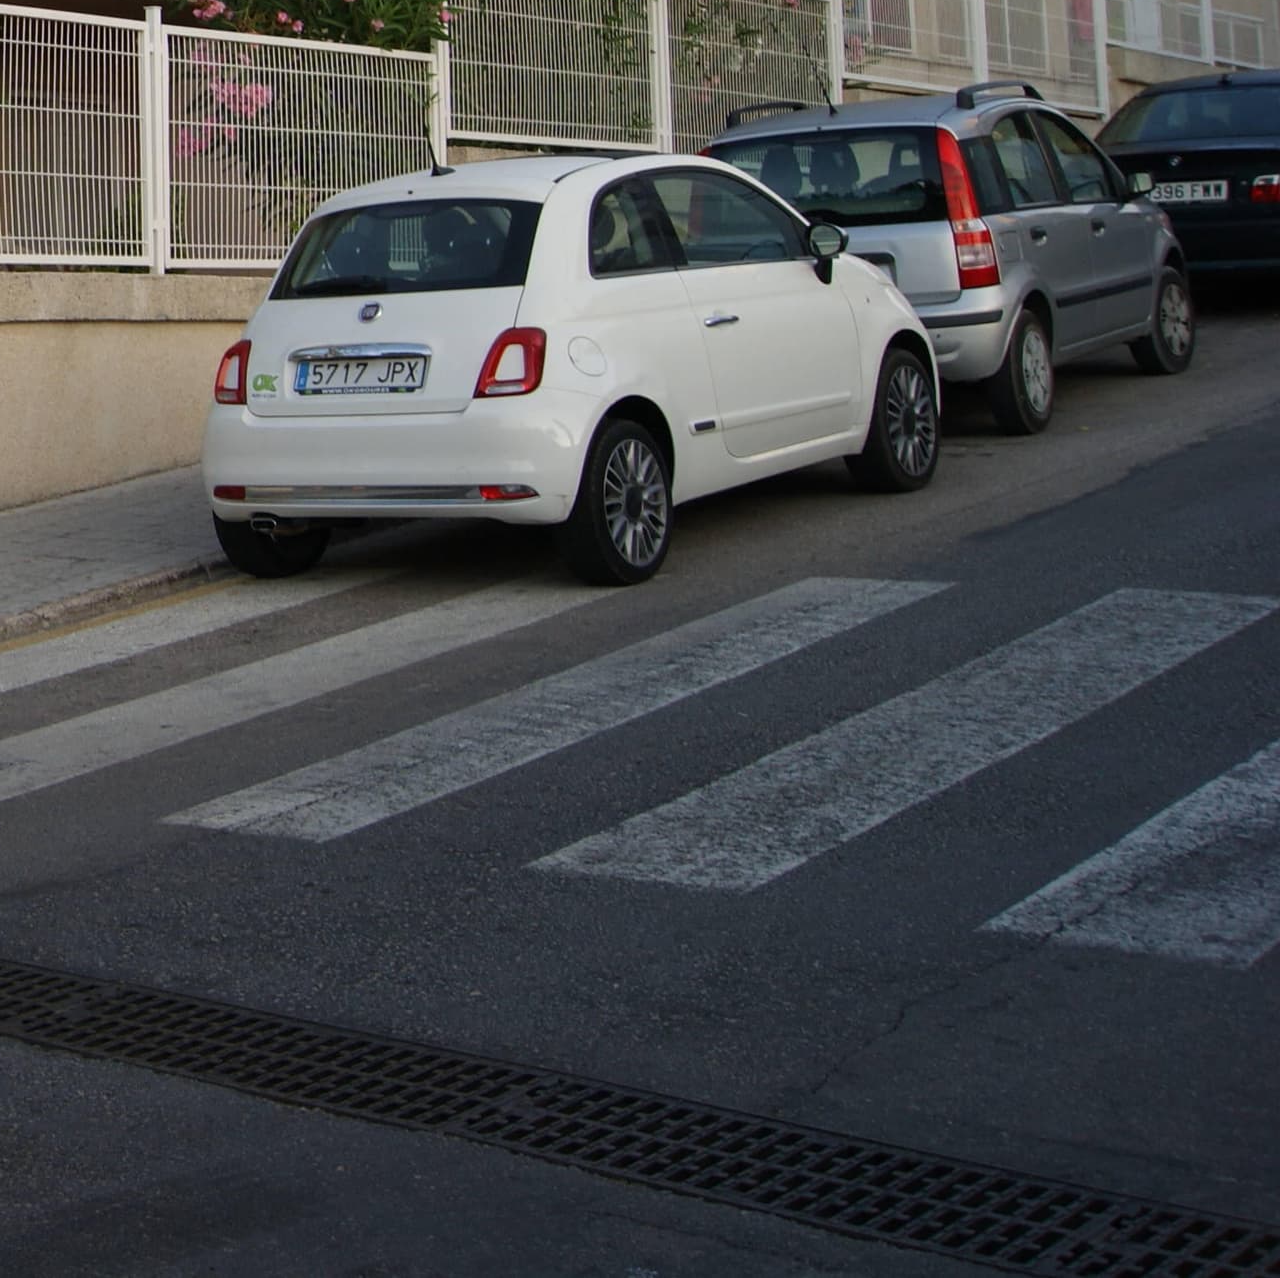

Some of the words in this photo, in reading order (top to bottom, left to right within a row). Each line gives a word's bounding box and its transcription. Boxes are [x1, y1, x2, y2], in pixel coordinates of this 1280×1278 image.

[1151, 184, 1185, 200] 396
[312, 362, 369, 385] 5717
[378, 361, 419, 383] JPX
